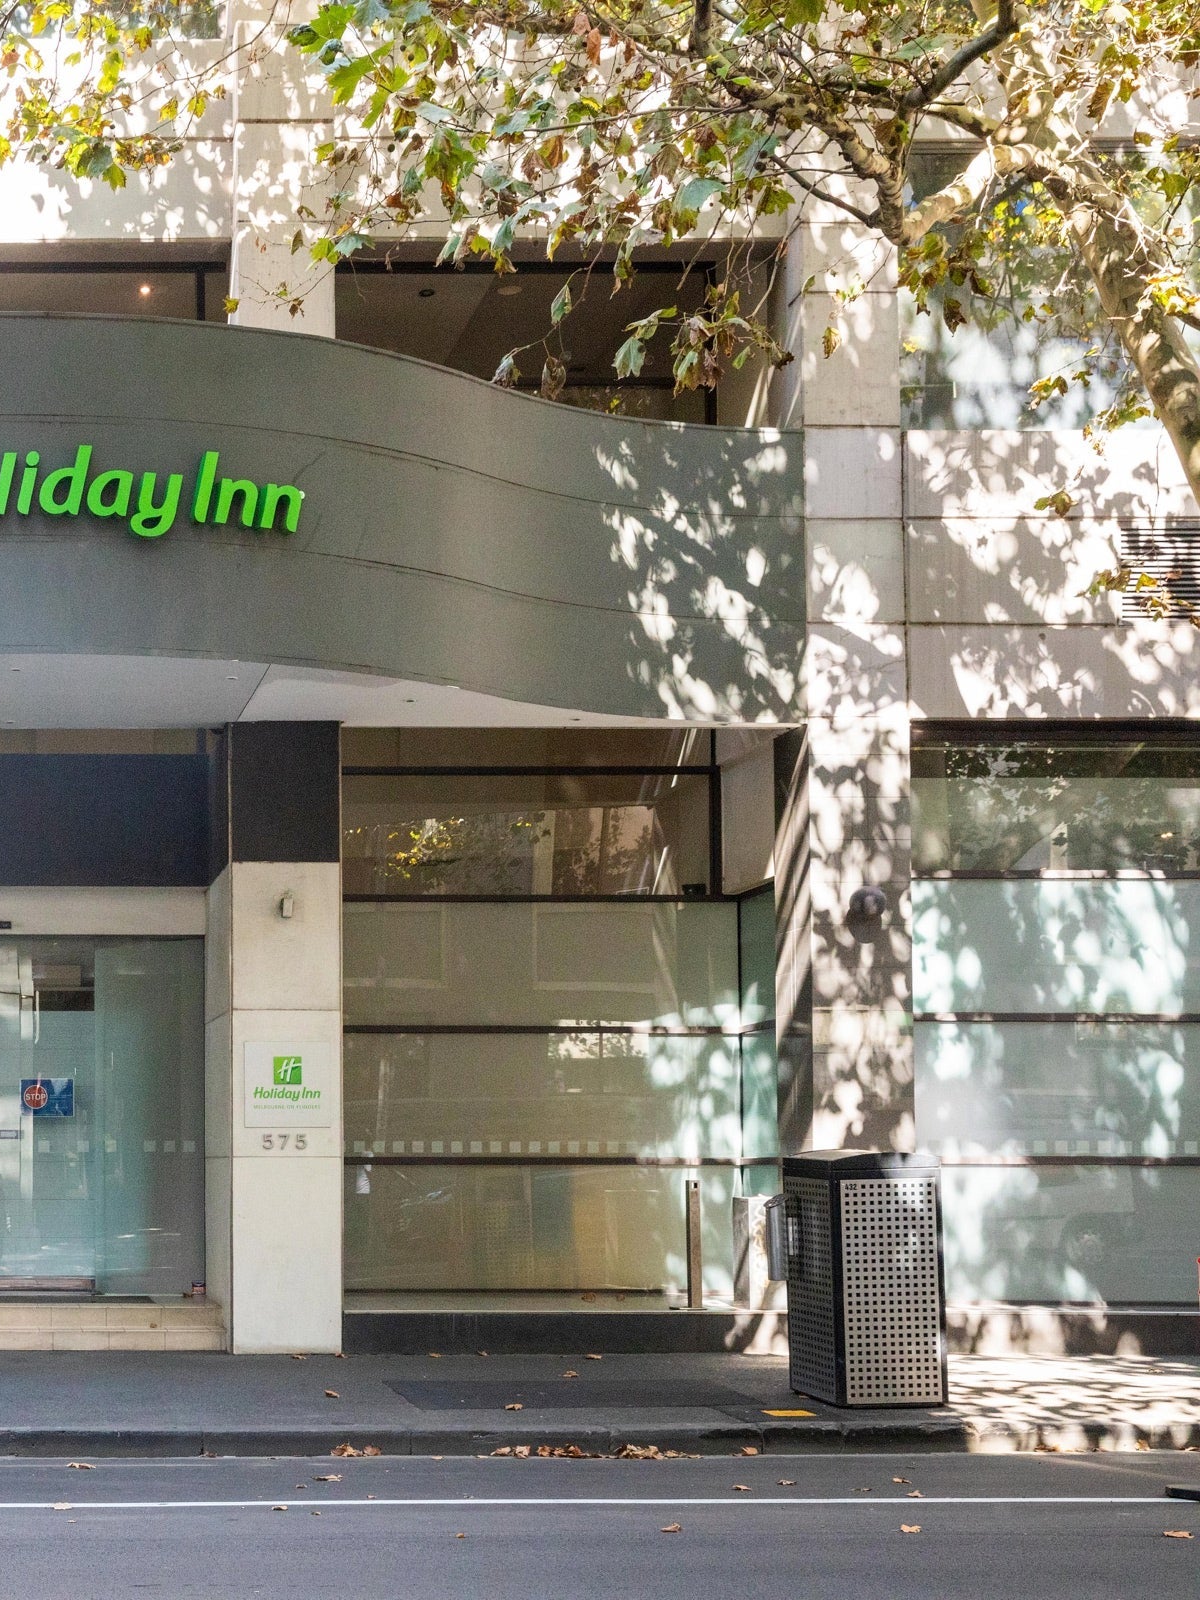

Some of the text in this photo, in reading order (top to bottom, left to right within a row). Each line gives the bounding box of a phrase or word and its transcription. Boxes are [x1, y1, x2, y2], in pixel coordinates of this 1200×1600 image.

[193, 451, 303, 533] Inn
[25, 1093, 46, 1101] STOP
[253, 1086, 321, 1102] Holiday Inn
[261, 1133, 308, 1150] 575
